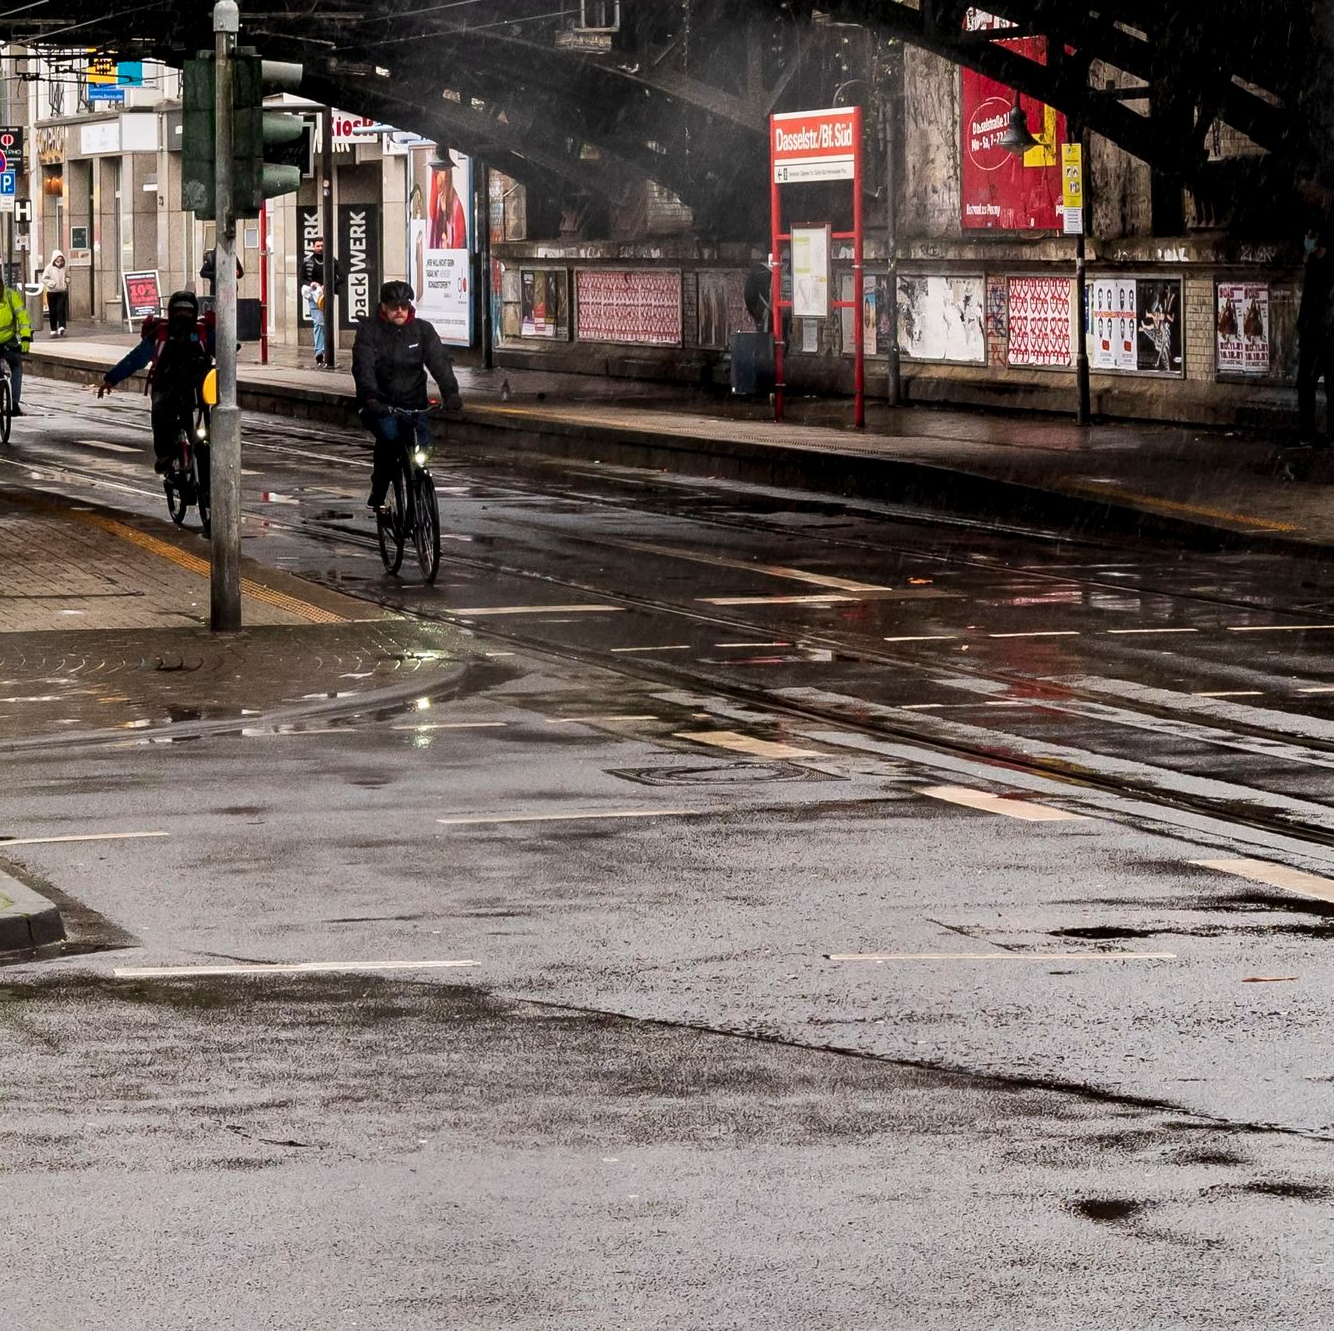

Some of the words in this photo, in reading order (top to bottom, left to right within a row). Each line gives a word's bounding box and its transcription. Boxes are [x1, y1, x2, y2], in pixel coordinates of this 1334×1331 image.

[3, 175, 12, 192] P
[15, 201, 31, 222] H
[130, 284, 156, 296] 10%
